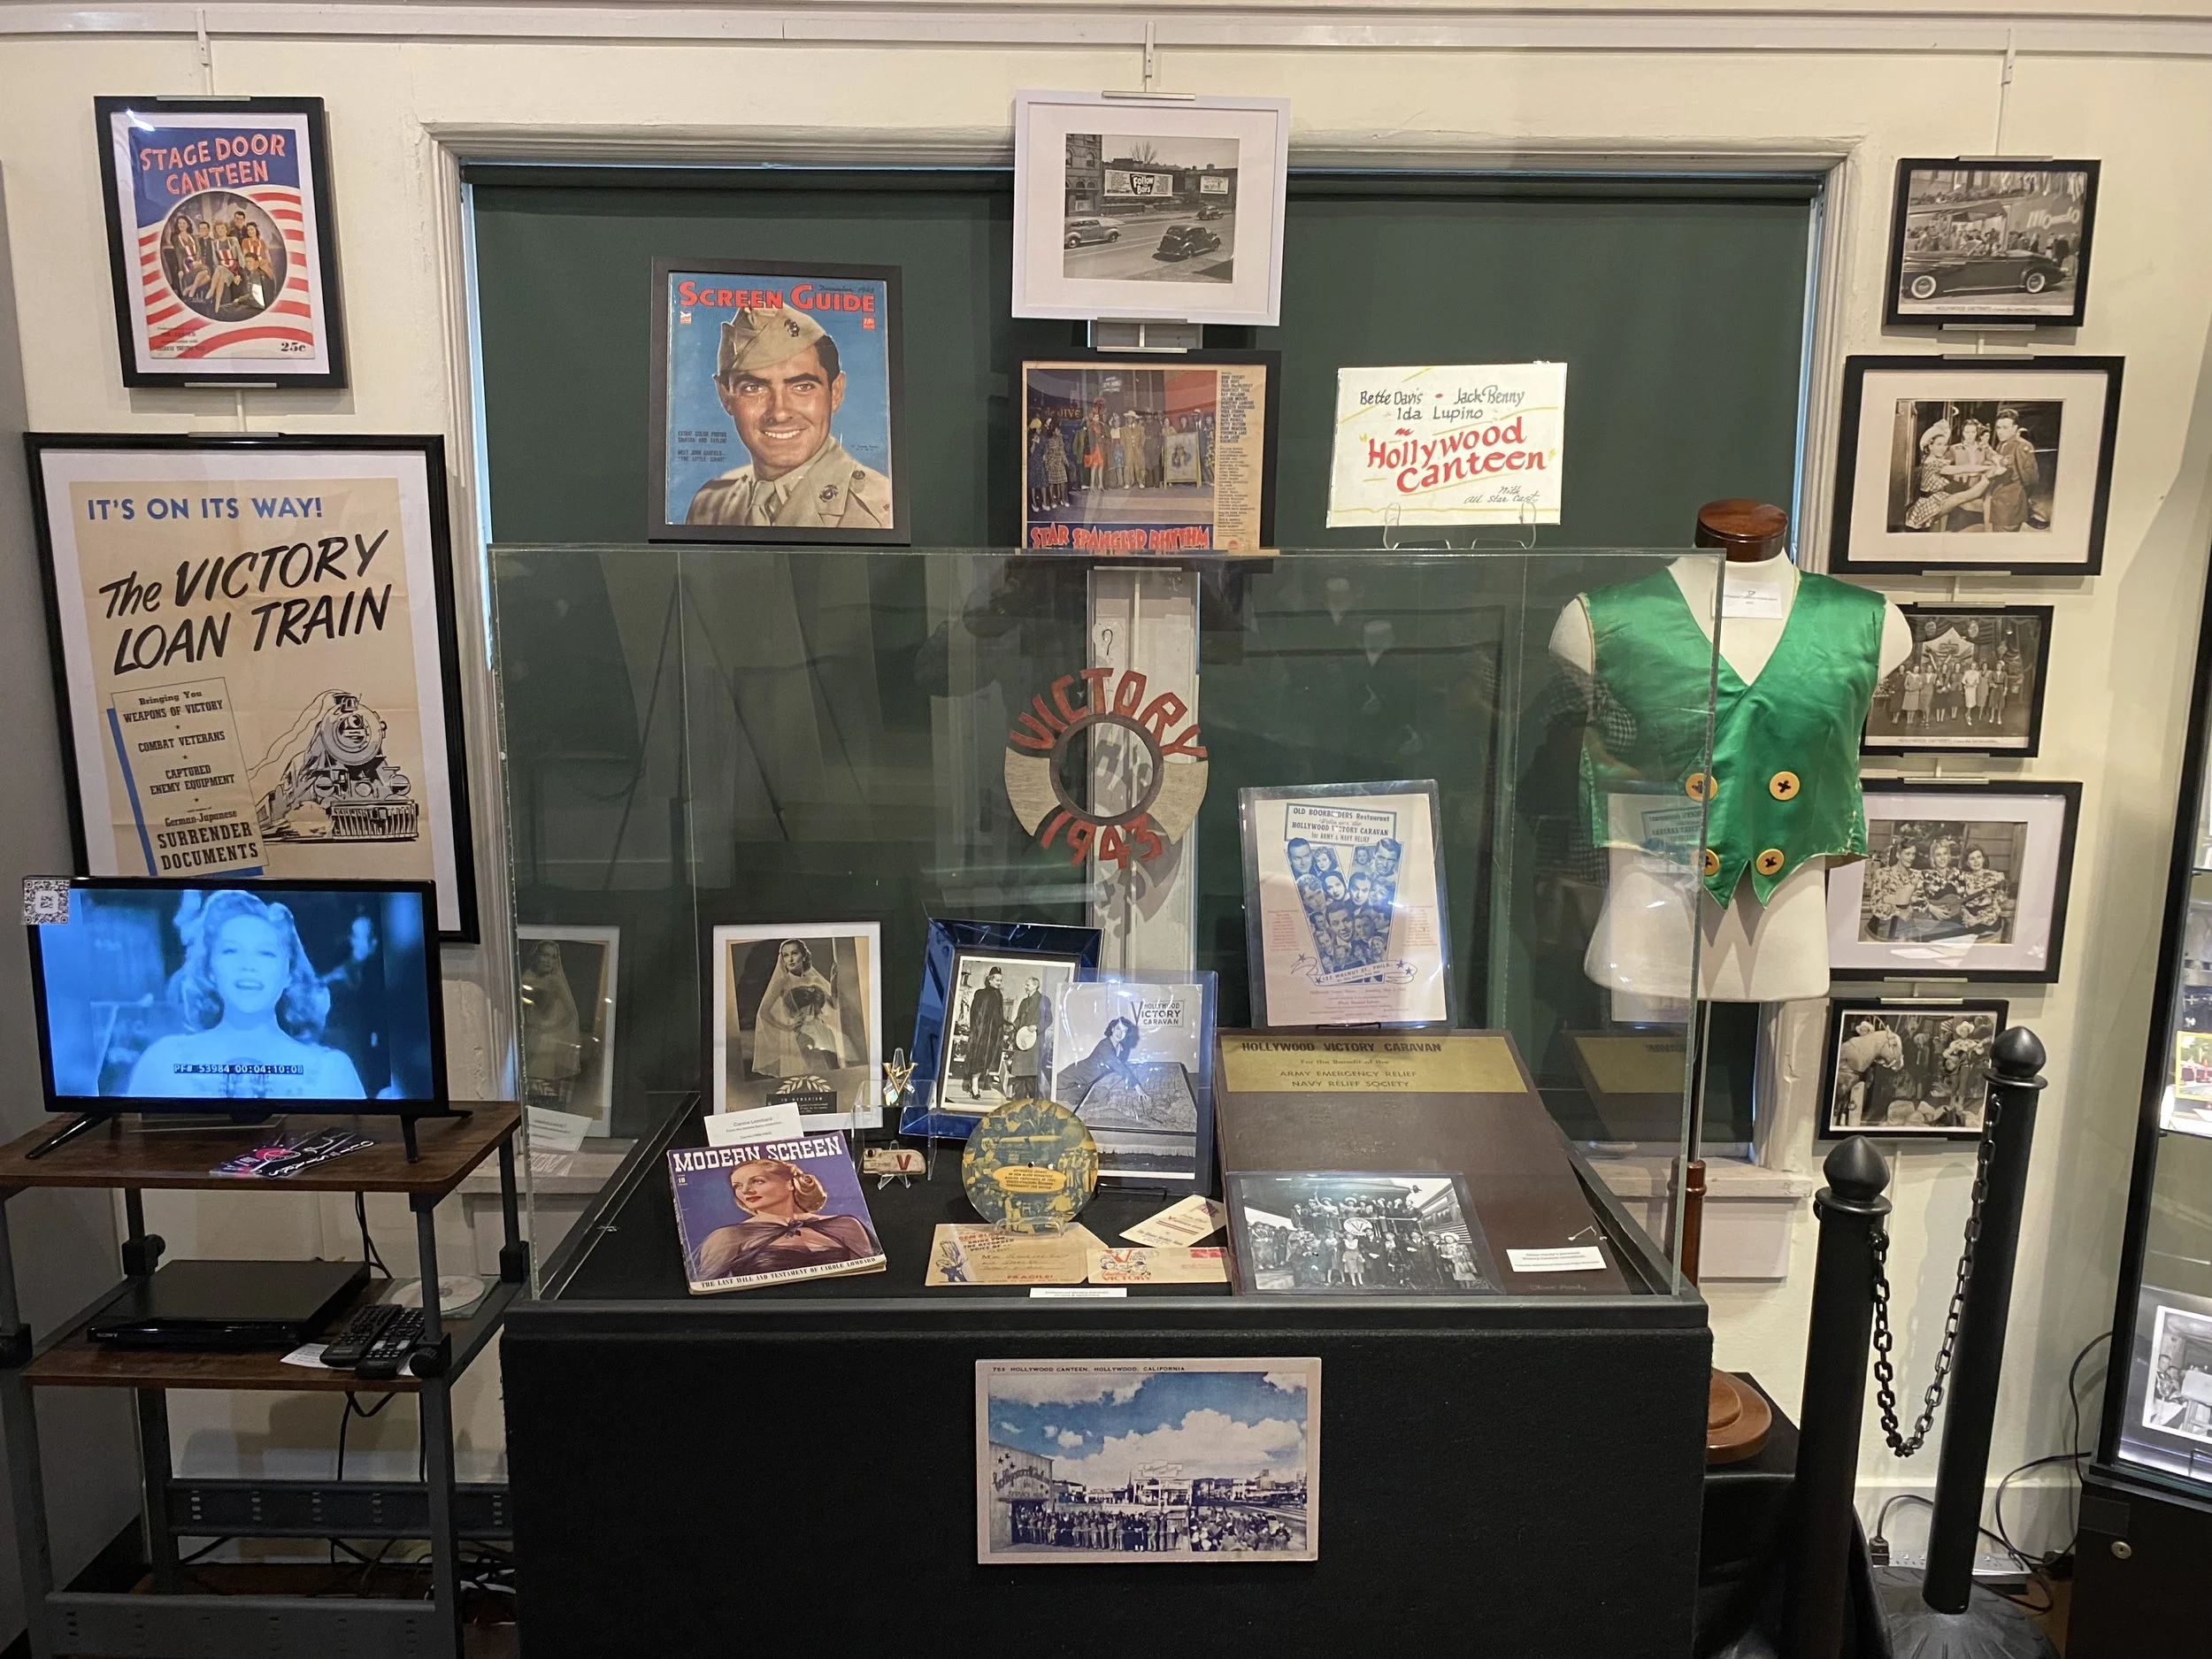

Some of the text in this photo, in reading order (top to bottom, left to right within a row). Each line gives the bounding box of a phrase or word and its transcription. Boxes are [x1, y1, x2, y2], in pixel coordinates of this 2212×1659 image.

[140, 134, 285, 171] STAGE DOOR
[165, 160, 268, 195] CANTEEN
[678, 280, 876, 313] SCREEN GUIDE
[1360, 385, 1525, 406] Bette Davis Jack Benny
[1397, 406, 1484, 423] Ida Lupino
[1368, 417, 1527, 469] Hollywood
[1396, 450, 1547, 493] Canteen
[88, 497, 322, 520] IT'S ON ITS WAY!
[1031, 522, 1210, 553] STAR SPANGLED RHYTHM
[99, 529, 389, 618] The VICTORY
[113, 583, 393, 676] LOAN TRAIN
[138, 693, 180, 705] Bringing
[123, 700, 223, 723] WEAPONS OF VICTORY
[1009, 667, 1208, 757] VICTORY
[138, 731, 226, 752] COMBAT VETERANS
[165, 764, 211, 780] CAPTURED
[150, 774, 235, 795] ENEMY EQUIPMENT
[165, 810, 238, 827] German-Japanese
[1309, 809, 1353, 819] BOOKBDERS
[1356, 813, 1390, 822] Restaurant
[157, 821, 253, 849] SURRENDER
[1040, 810, 1163, 871] 1943
[1292, 822, 1330, 831] HOLLYWOOD
[1360, 827, 1388, 836] CARAVAN
[161, 842, 258, 871] DOCUMENTS
[1242, 1042, 1441, 1052] HOLLYWOOD VICTORY CARAVAN
[199, 1064, 230, 1073] 53984
[672, 1136, 842, 1172] MODERN SCREEN
[896, 1154, 911, 1170] V
[770, 1268, 808, 1279] TESTAMENT
[820, 1263, 843, 1271] CAROLE
[847, 1257, 876, 1269] LOMBARD
